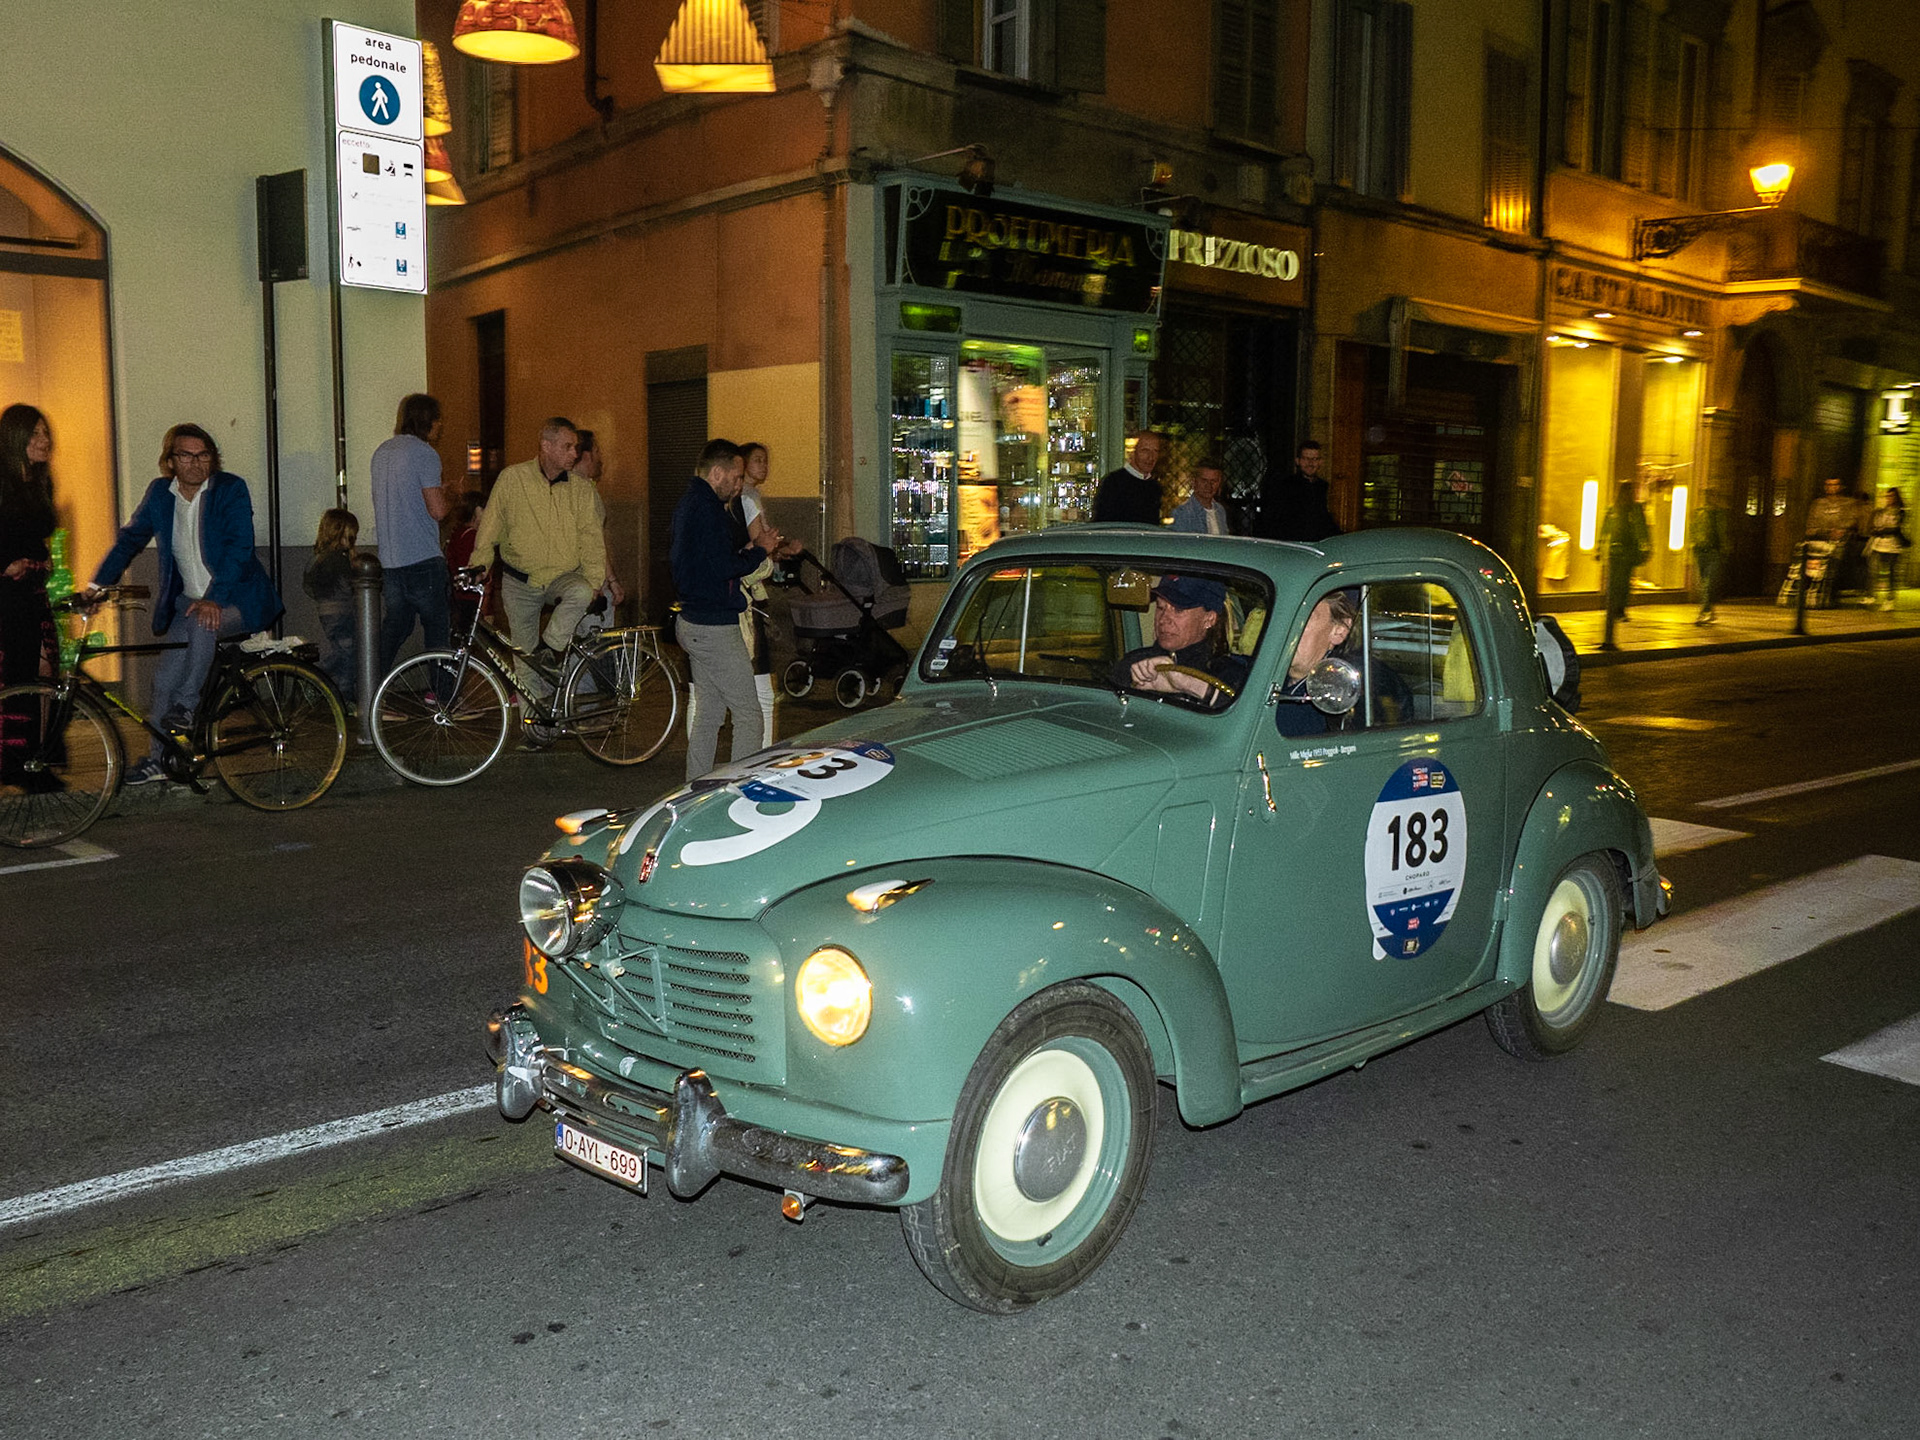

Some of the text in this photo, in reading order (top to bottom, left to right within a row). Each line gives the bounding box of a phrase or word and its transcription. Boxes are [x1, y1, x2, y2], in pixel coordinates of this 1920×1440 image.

[350, 53, 407, 74] pedonale
[365, 37, 392, 51] area
[944, 204, 1137, 268] PROFUMERIA
[1168, 228, 1300, 281] PREZIOSO
[1387, 807, 1449, 872] 183
[565, 1129, 637, 1179] O-AYL-699
